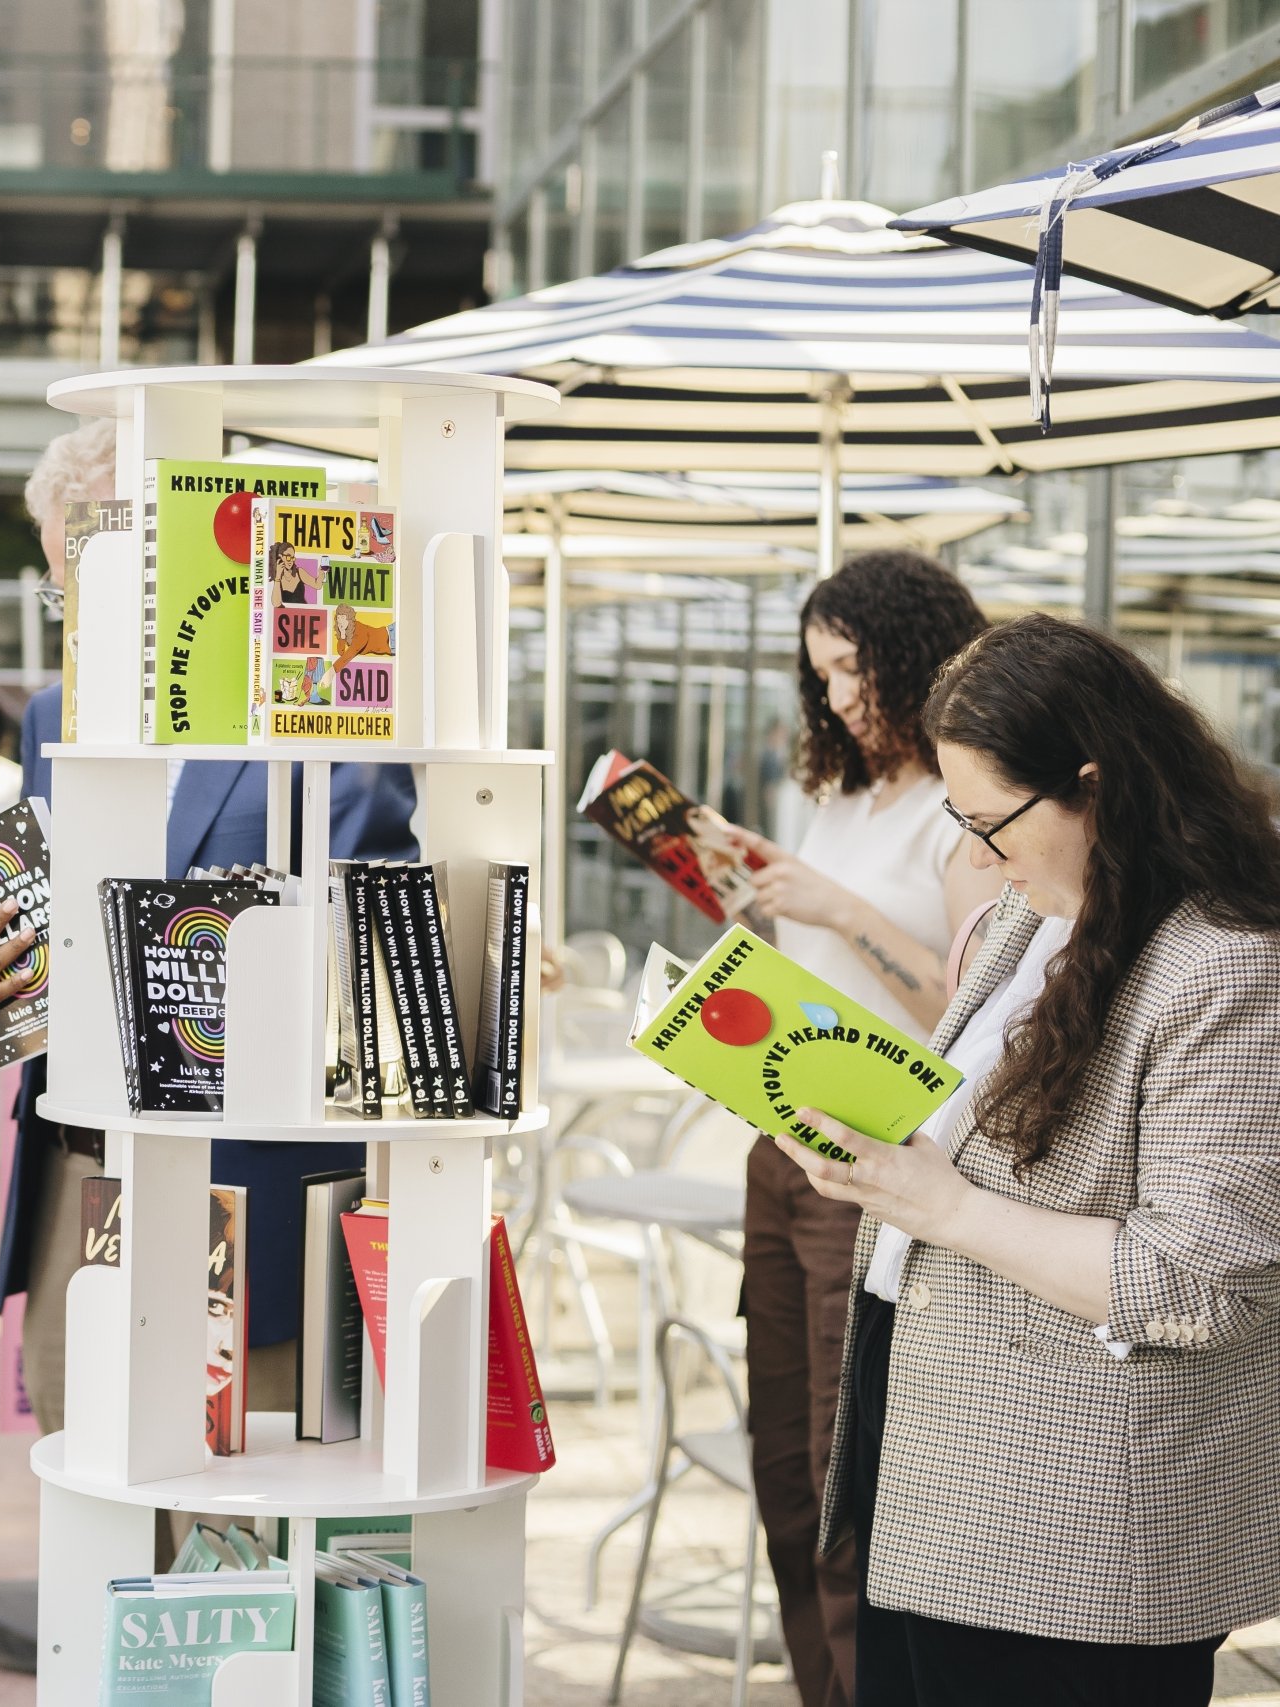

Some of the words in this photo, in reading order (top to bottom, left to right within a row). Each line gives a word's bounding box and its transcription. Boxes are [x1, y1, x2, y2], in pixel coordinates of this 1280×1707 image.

[171, 475, 245, 493] KRISTEN
[253, 479, 319, 498] ARNETT
[95, 508, 133, 531] THE
[278, 513, 354, 550] THAT'S
[256, 524, 264, 556] THAT'S
[255, 560, 263, 585] WHAT
[326, 566, 390, 602] WHAT
[187, 576, 249, 620] YOU'VE
[177, 620, 197, 642] IF
[254, 612, 262, 633] SAID
[277, 614, 320, 649] SHE
[170, 647, 191, 676] ME
[340, 668, 389, 702] SAID
[169, 683, 191, 733] STOP
[275, 714, 332, 735] ELEANOR
[337, 716, 391, 736] PILCHER
[4, 871, 33, 892] WIN
[34, 866, 45, 879] A
[356, 887, 365, 914] HOW
[378, 890, 390, 917] HOW
[398, 889, 410, 917] HOW
[423, 889, 435, 916] HOW
[514, 889, 523, 917] HOW
[358, 917, 366, 932] TO
[384, 919, 393, 934] TO
[405, 919, 413, 934] TO
[428, 919, 437, 934] TO
[513, 919, 521, 934] TO
[143, 945, 186, 960] HOW
[191, 949, 214, 962] TO
[359, 934, 368, 956] WIN
[387, 935, 398, 957] WIN
[407, 935, 418, 957] WIN
[431, 935, 441, 957] WIN
[512, 936, 521, 957] WIN
[146, 960, 226, 984] MILLI
[147, 982, 226, 1003] DOLL
[361, 968, 371, 1014] MILLION
[393, 969, 410, 1014] MILLION
[413, 969, 429, 1014] MILLION
[435, 969, 451, 1015] MILLION
[510, 970, 520, 1016] MILLION
[652, 992, 708, 1051] KRISTEN
[703, 940, 754, 994] ARNETT
[8, 1005, 33, 1022] luke
[149, 1004, 178, 1016] AND
[182, 1007, 215, 1018] BEEP
[363, 1018, 374, 1069] DOLLARS
[403, 1018, 420, 1068] DOLLARS
[422, 1017, 439, 1069] DOLLARS
[444, 1018, 460, 1069] DOLLARS
[507, 1020, 518, 1070] DOLLARS
[787, 1026, 860, 1046] HEARD
[865, 1033, 909, 1065] THIS
[180, 1064, 210, 1076] luke
[762, 1041, 791, 1103] YOU'VE
[908, 1060, 945, 1093] ONE
[774, 1103, 796, 1120] IF
[789, 1121, 819, 1144] ME
[818, 1140, 858, 1163] TOP
[496, 1233, 506, 1257] THE
[502, 1257, 514, 1296] THREE
[510, 1296, 522, 1329] LIVES
[517, 1330, 526, 1344] OF
[521, 1347, 532, 1376] CATE
[528, 1376, 538, 1398] KAY
[534, 1428, 547, 1461] FAGAN
[543, 1426, 552, 1453] KATE
[120, 1607, 280, 1649] SALTY
[366, 1605, 383, 1662] SALTY
[410, 1602, 426, 1660] SALTY
[119, 1656, 164, 1671] Kate
[168, 1654, 223, 1671] Myers
[372, 1678, 386, 1707] Ka
